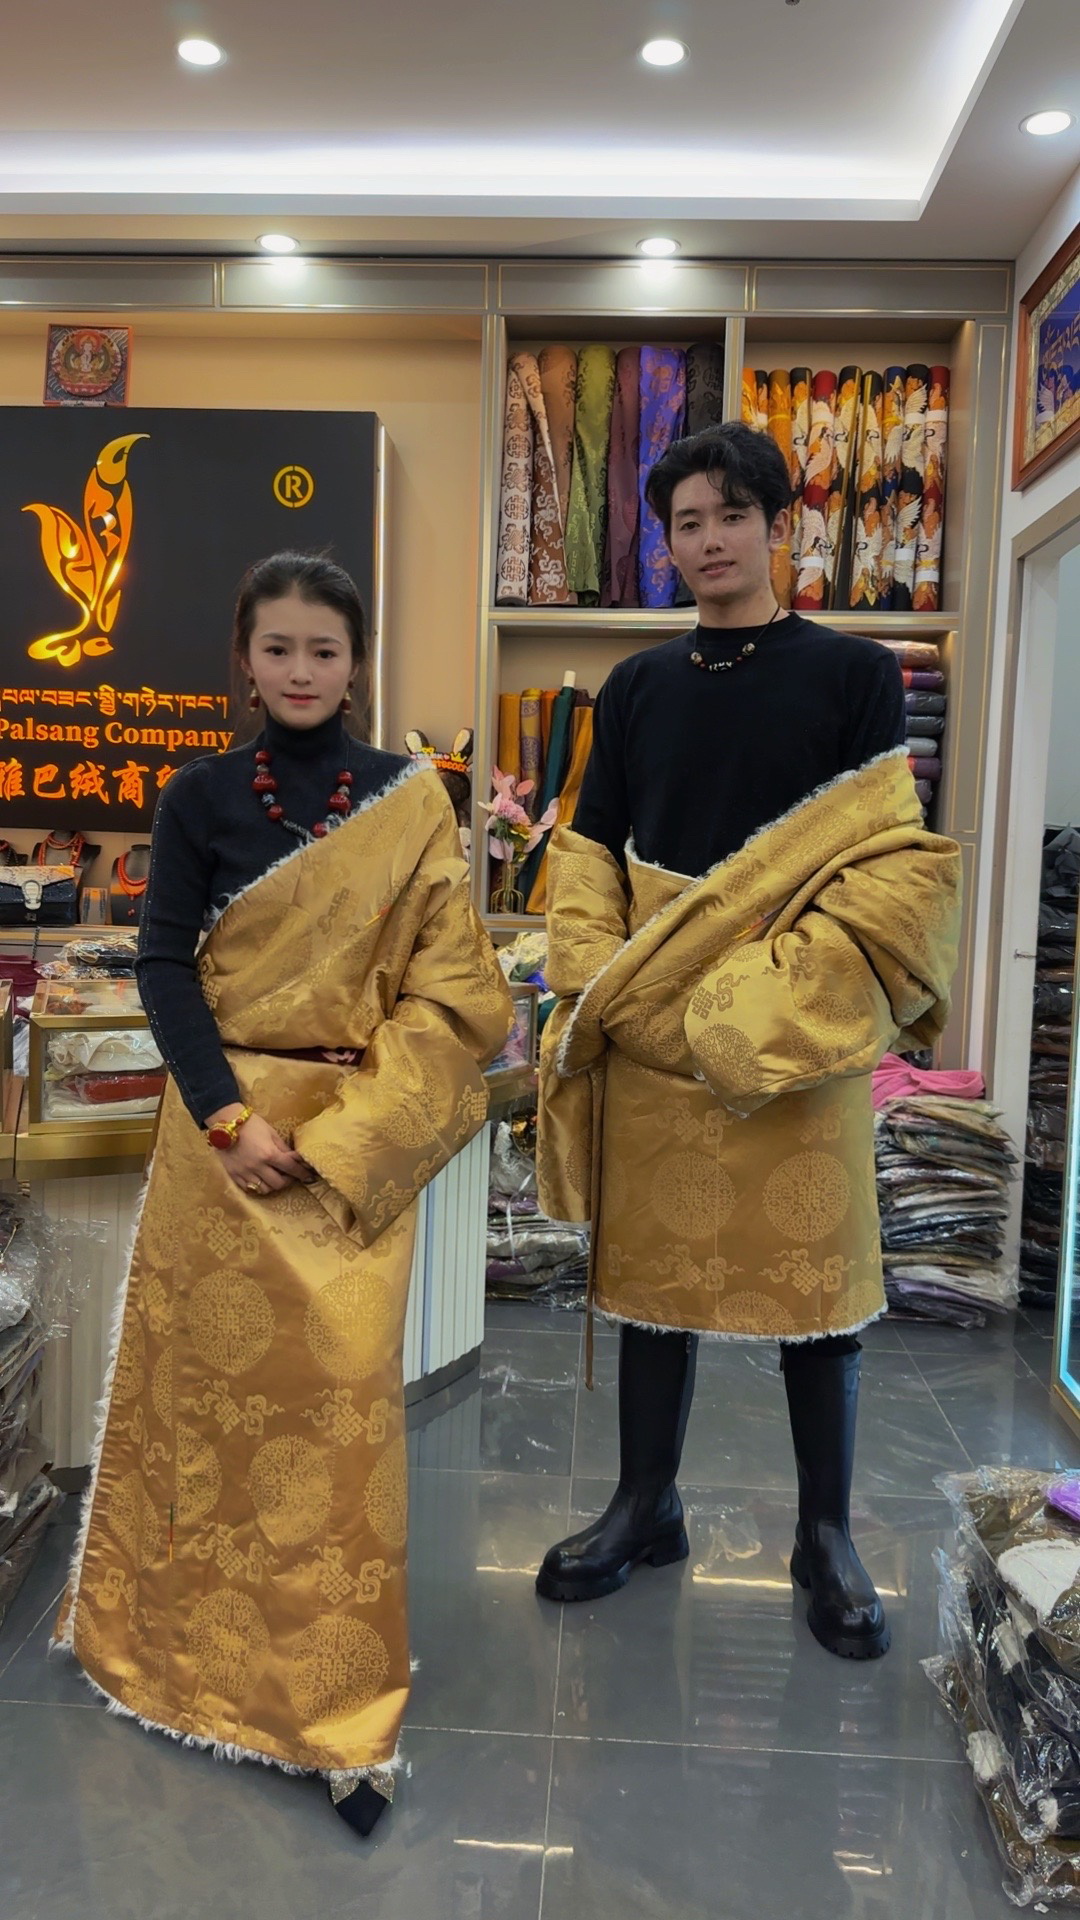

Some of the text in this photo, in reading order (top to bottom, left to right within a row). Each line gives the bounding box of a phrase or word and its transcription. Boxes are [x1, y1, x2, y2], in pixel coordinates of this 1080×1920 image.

[0, 717, 234, 754] Palsang Company
[0, 757, 178, 809] 雅巴绒商
